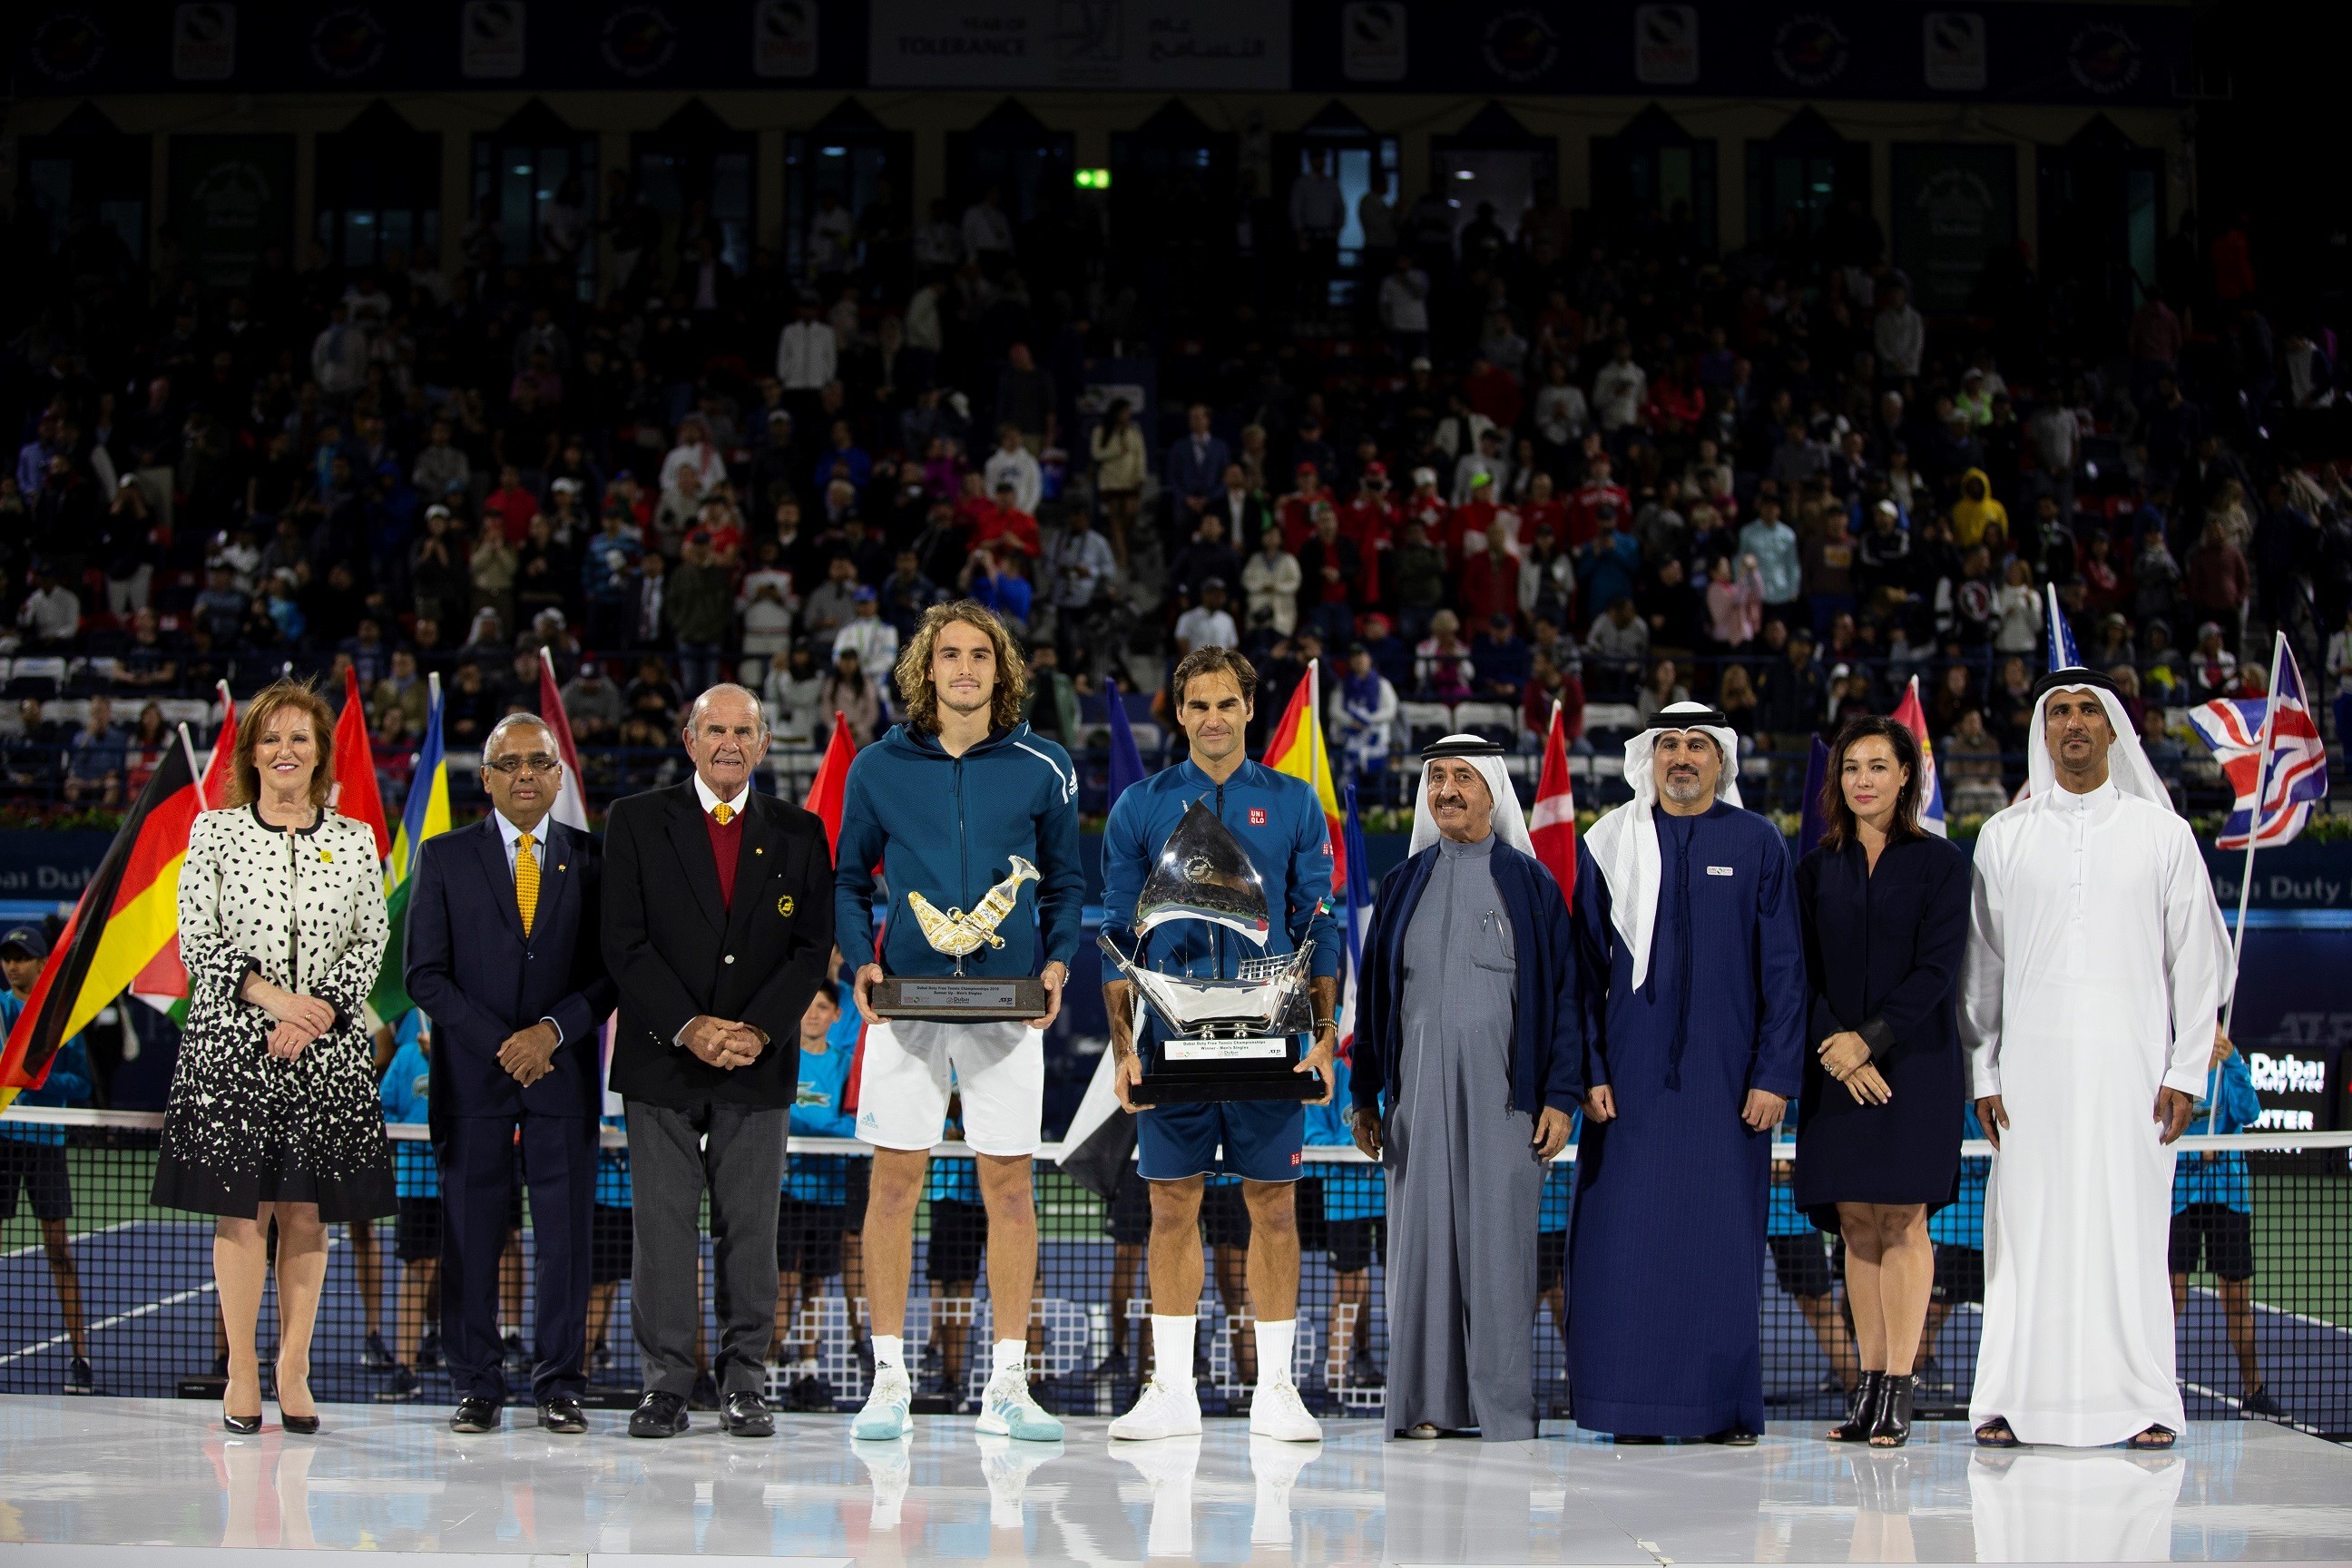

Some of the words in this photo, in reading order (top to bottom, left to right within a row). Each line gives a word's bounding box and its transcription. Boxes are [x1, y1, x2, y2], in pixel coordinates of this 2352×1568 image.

[897, 34, 1027, 56] TOLERANCE
[37, 864, 92, 889] Dut
[2270, 875, 2342, 906] Duty
[2249, 1053, 2325, 1079] Dubai
[2242, 1109, 2314, 1131] NTER
